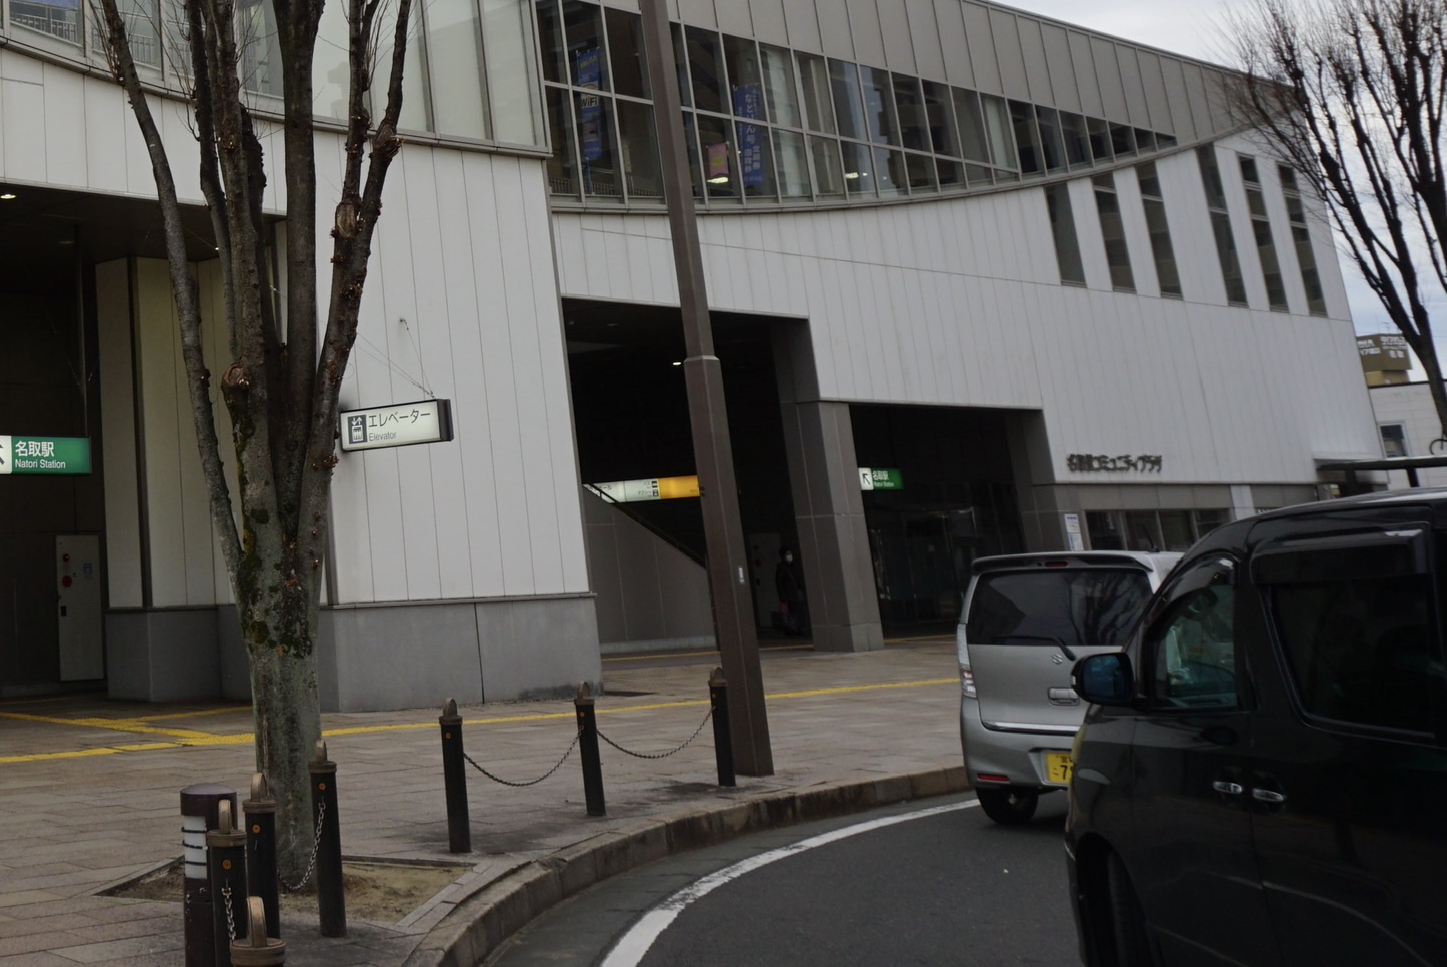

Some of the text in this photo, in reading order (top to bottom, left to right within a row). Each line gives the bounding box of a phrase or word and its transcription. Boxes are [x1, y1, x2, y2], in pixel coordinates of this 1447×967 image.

[368, 409, 431, 428] エレベーター
[368, 431, 397, 442] Elevator
[14, 440, 54, 458] 名取駅
[14, 458, 66, 469] Natori Station
